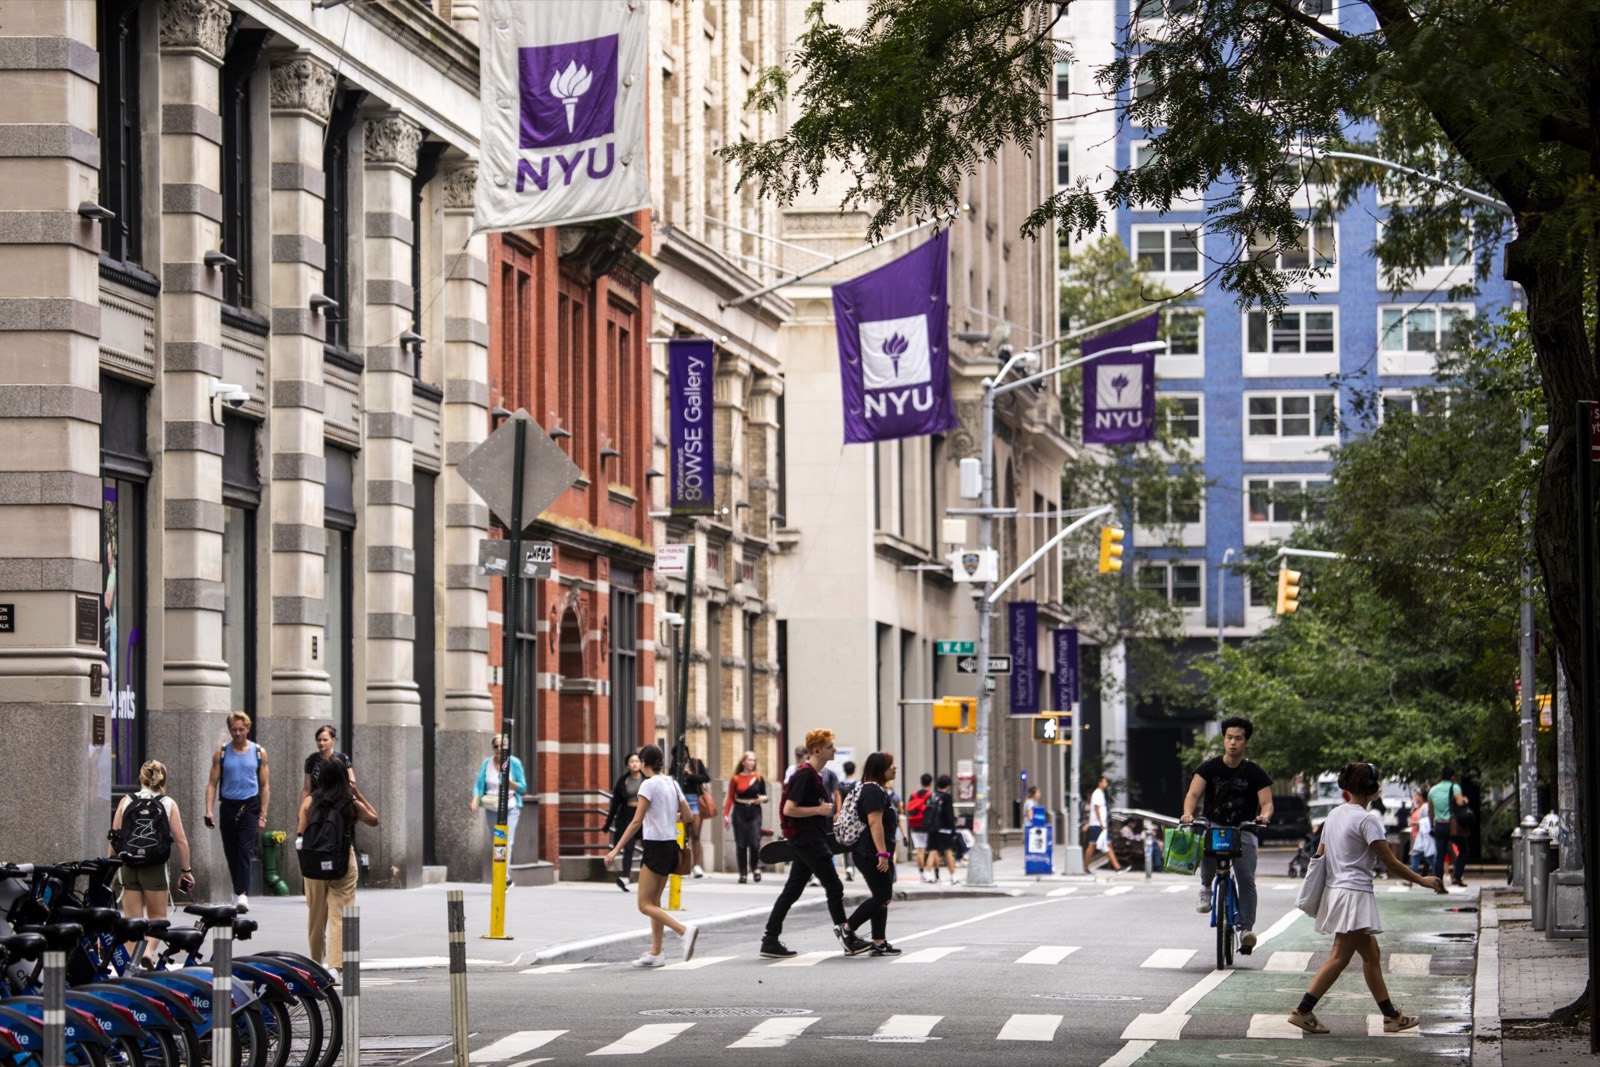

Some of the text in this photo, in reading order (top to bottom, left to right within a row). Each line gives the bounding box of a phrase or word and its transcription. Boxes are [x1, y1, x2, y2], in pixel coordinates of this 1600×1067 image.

[515, 141, 615, 193] NYU
[683, 355, 705, 423] Gallery
[863, 385, 934, 419] NYU
[1095, 410, 1143, 429] NYU
[942, 642, 951, 651] W
[953, 642, 961, 651] 4
[1013, 608, 1027, 706] Henry Kaufman
[1056, 635, 1068, 685] Kaufman
